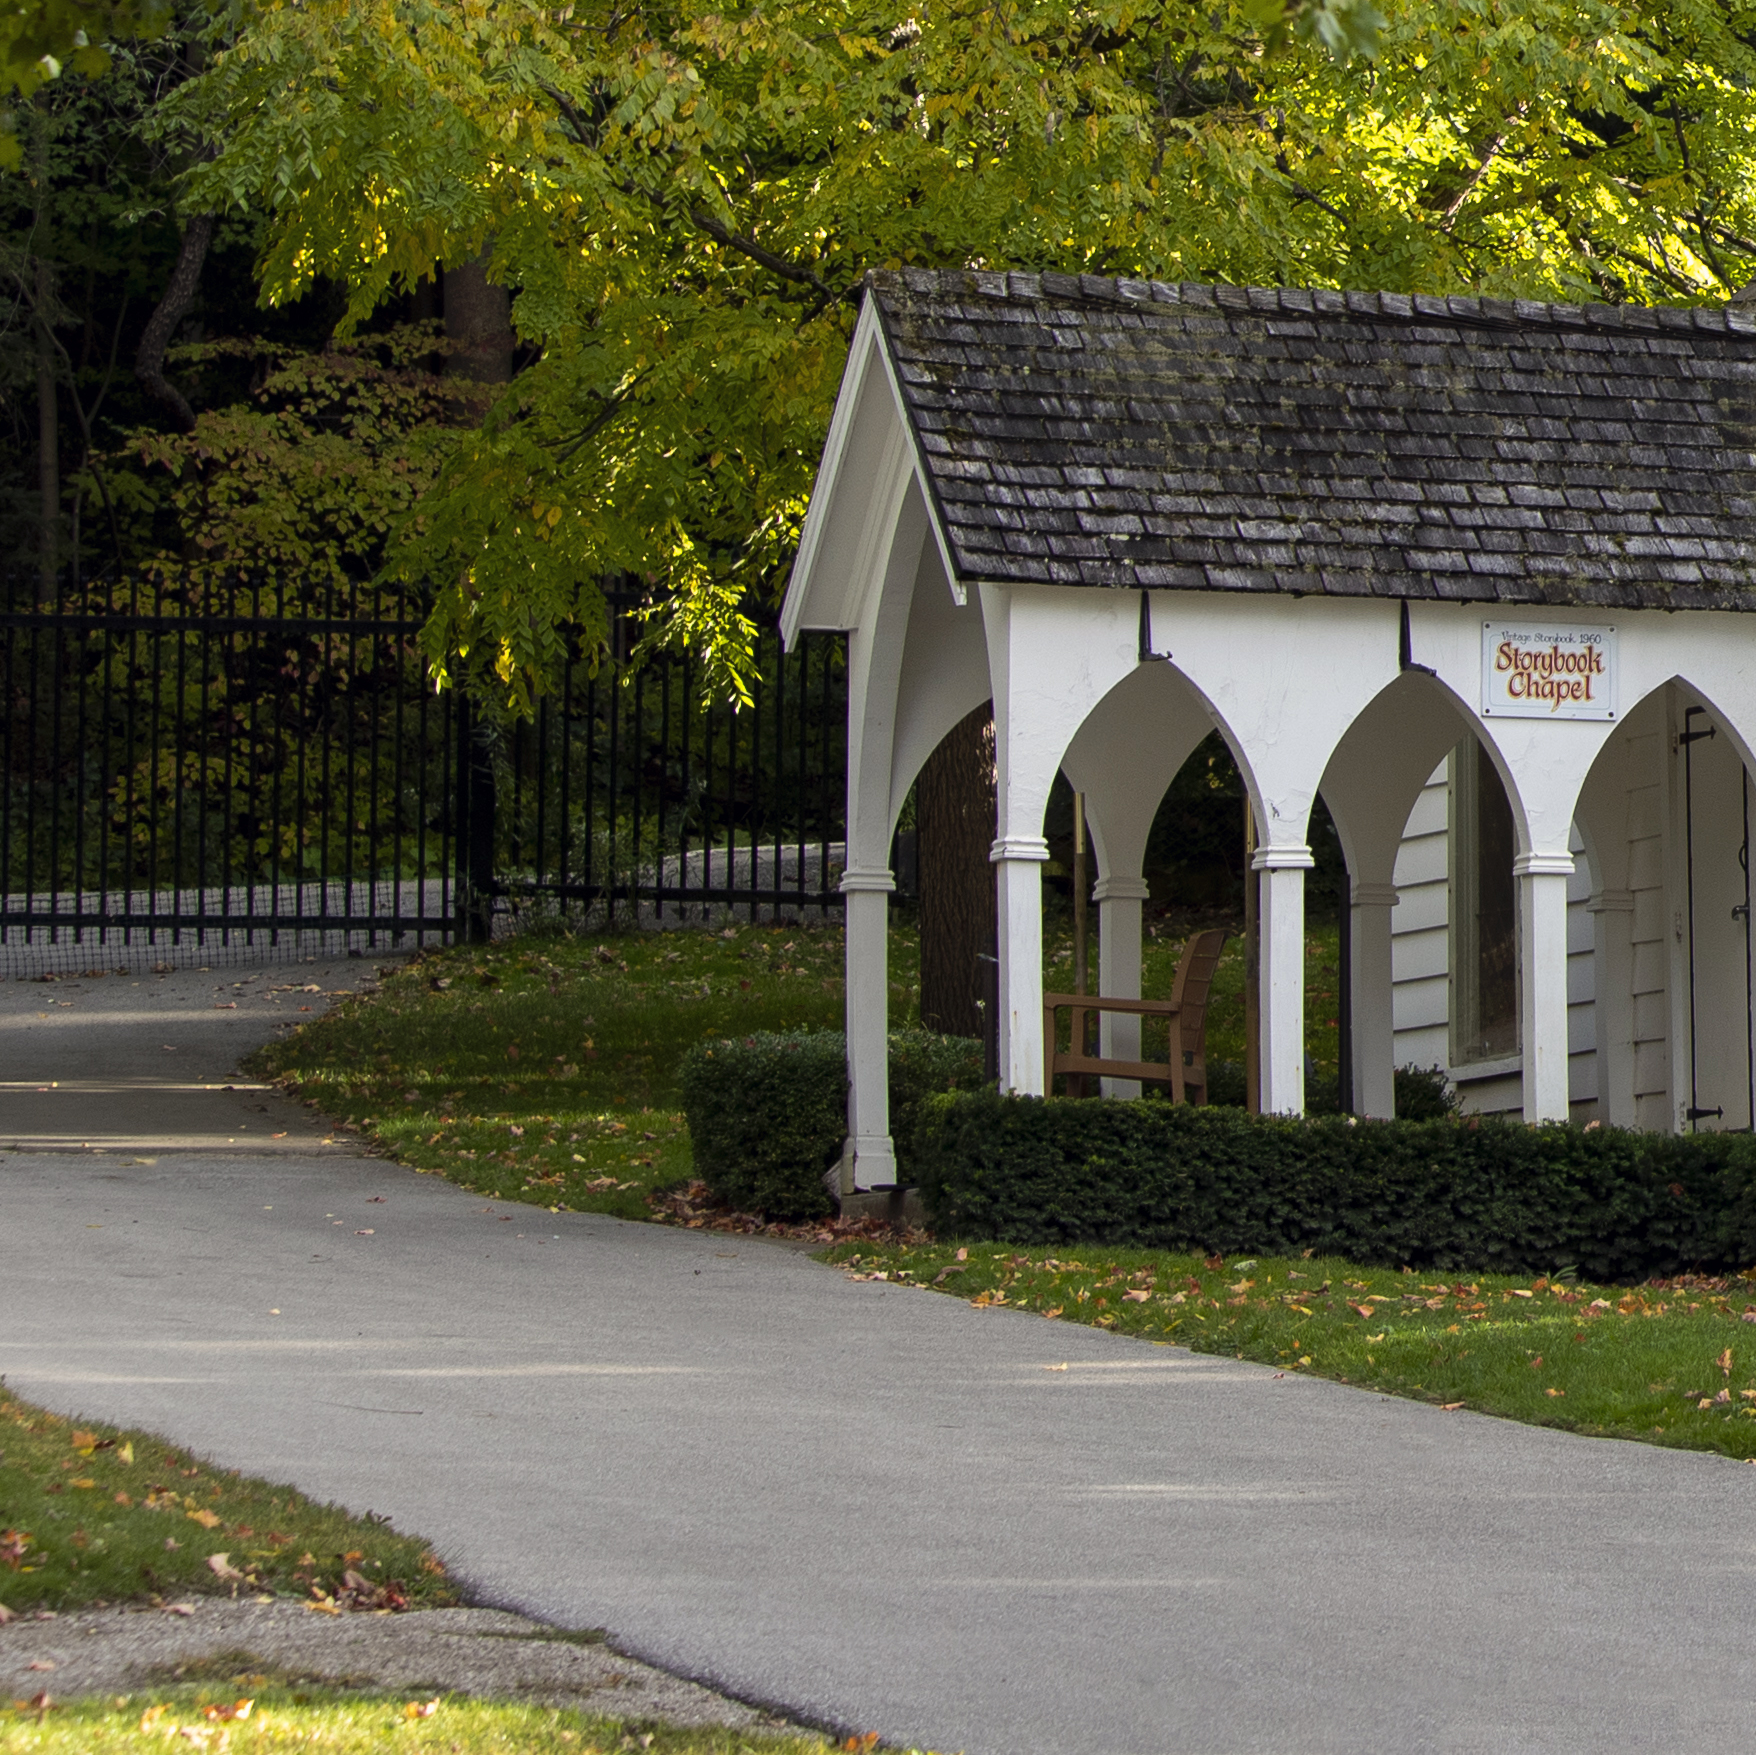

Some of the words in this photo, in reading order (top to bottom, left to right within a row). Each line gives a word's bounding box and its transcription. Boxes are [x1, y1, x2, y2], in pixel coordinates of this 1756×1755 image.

[1501, 630, 1532, 645] Vintage
[1534, 632, 1576, 645] Storybook
[1579, 633, 1602, 645] 1960
[1495, 640, 1606, 680] Storybook
[1507, 671, 1596, 713] Chapel
